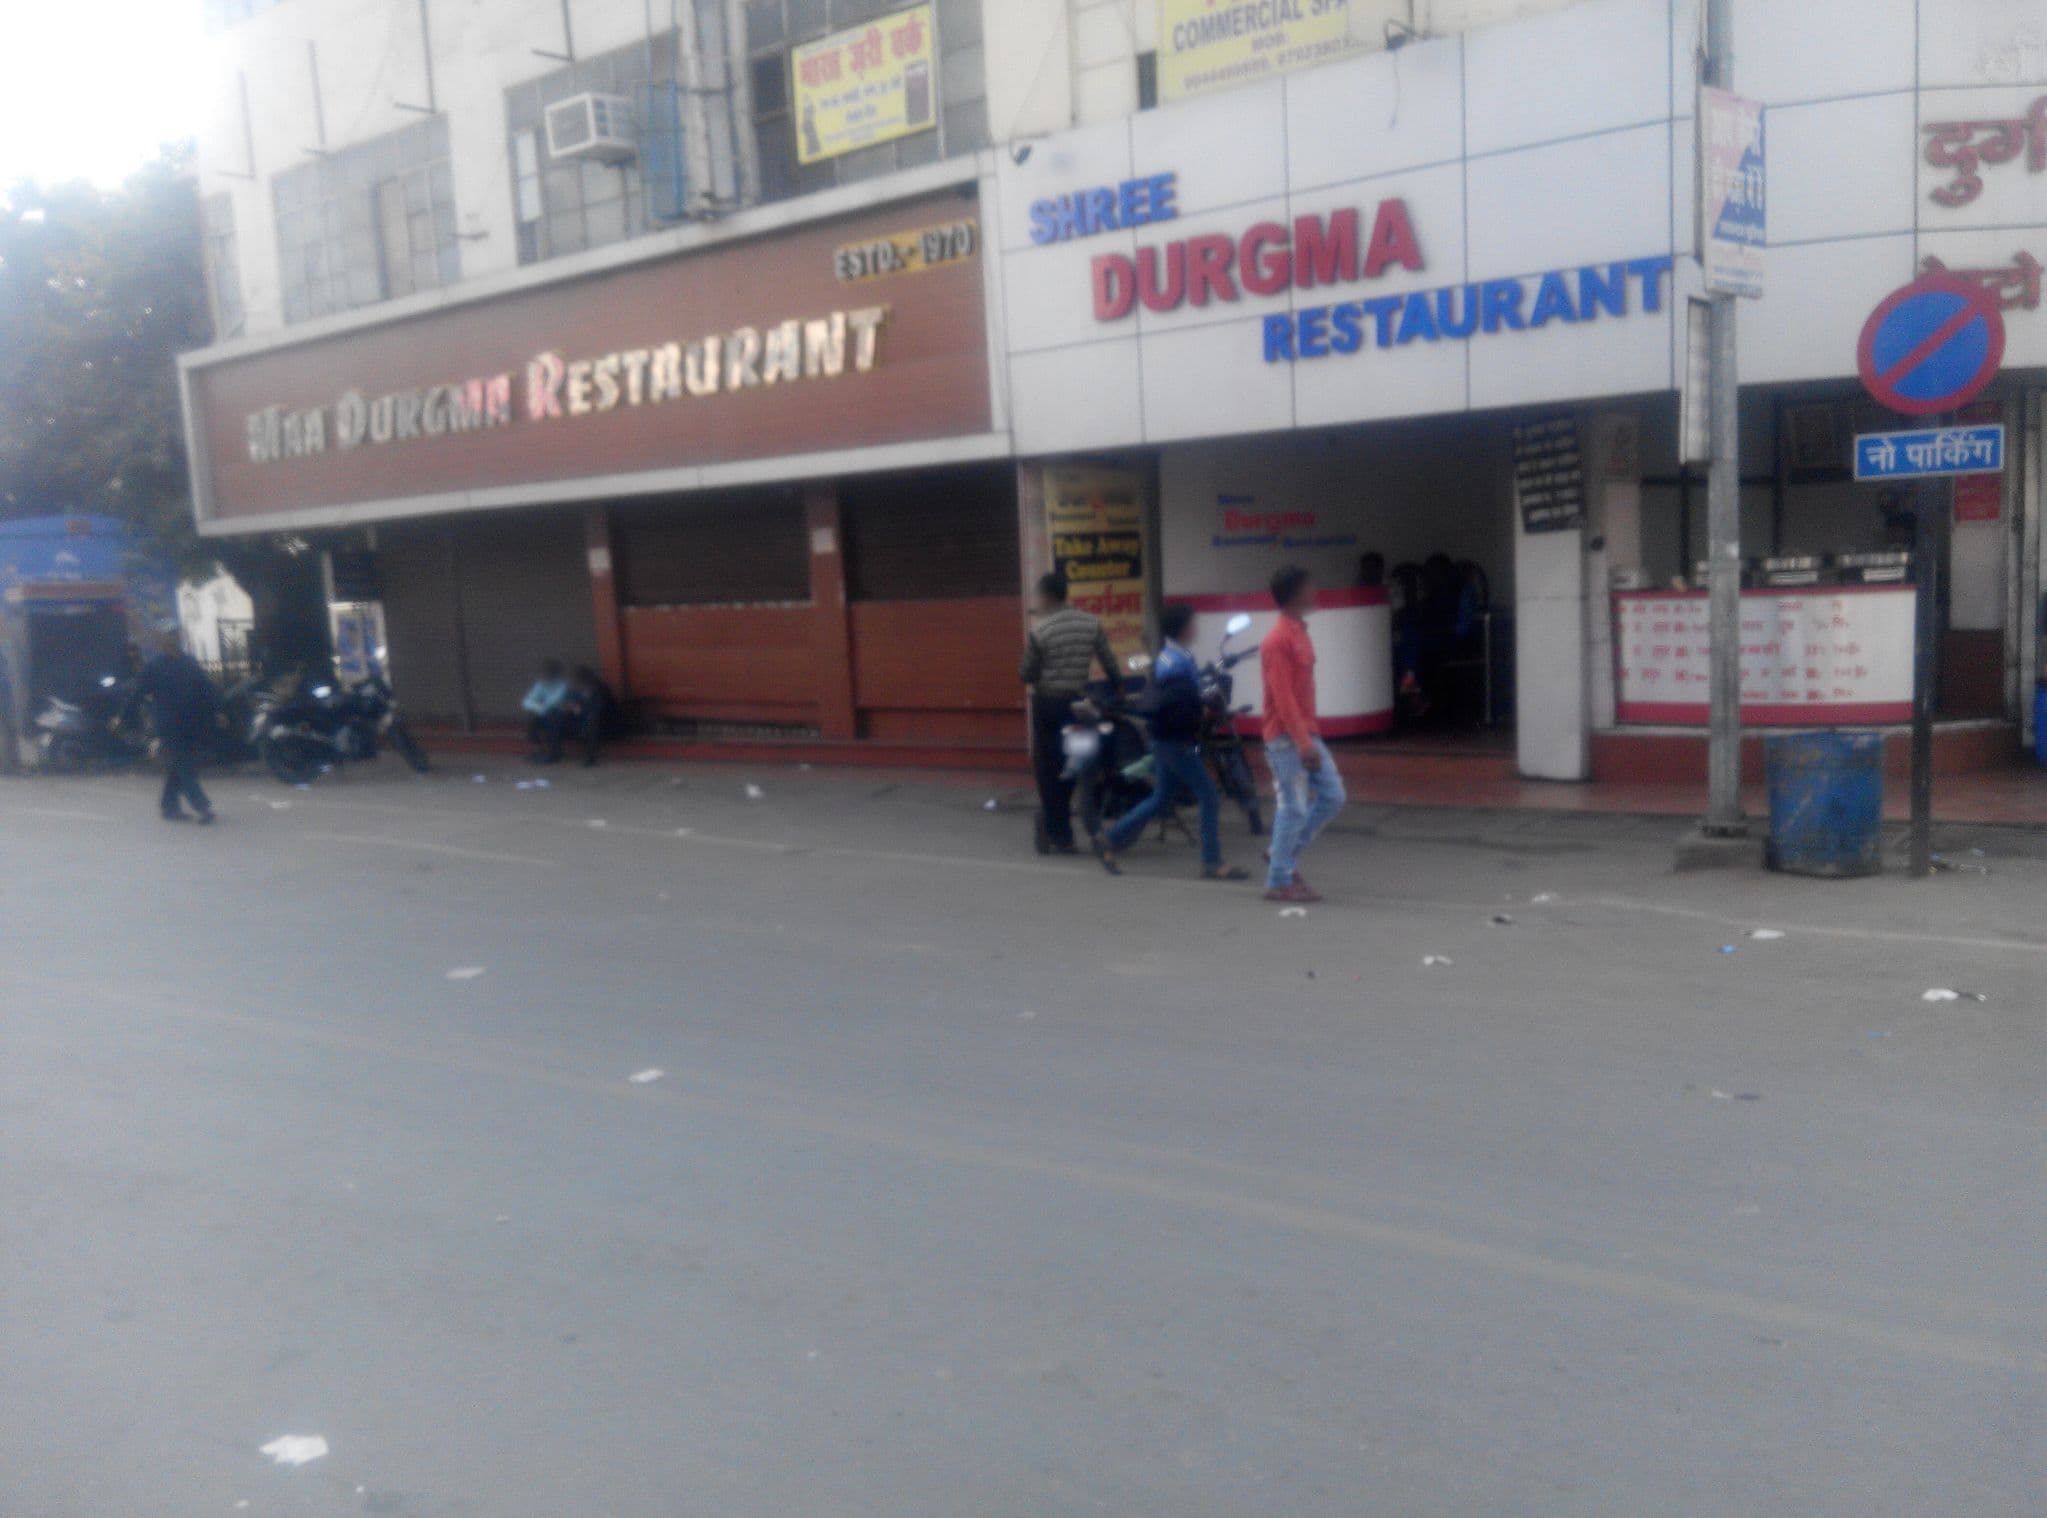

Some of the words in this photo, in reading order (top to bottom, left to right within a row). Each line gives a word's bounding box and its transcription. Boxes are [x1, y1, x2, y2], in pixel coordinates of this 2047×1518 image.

[1172, 0, 1304, 51] COMMERCIAL
[1029, 171, 1180, 247] SHREE
[1091, 197, 1426, 322] DURGMA
[1262, 254, 1674, 364] RESTAURANT
[526, 307, 886, 420] RESTAURANT
[1865, 436, 1896, 472] नो
